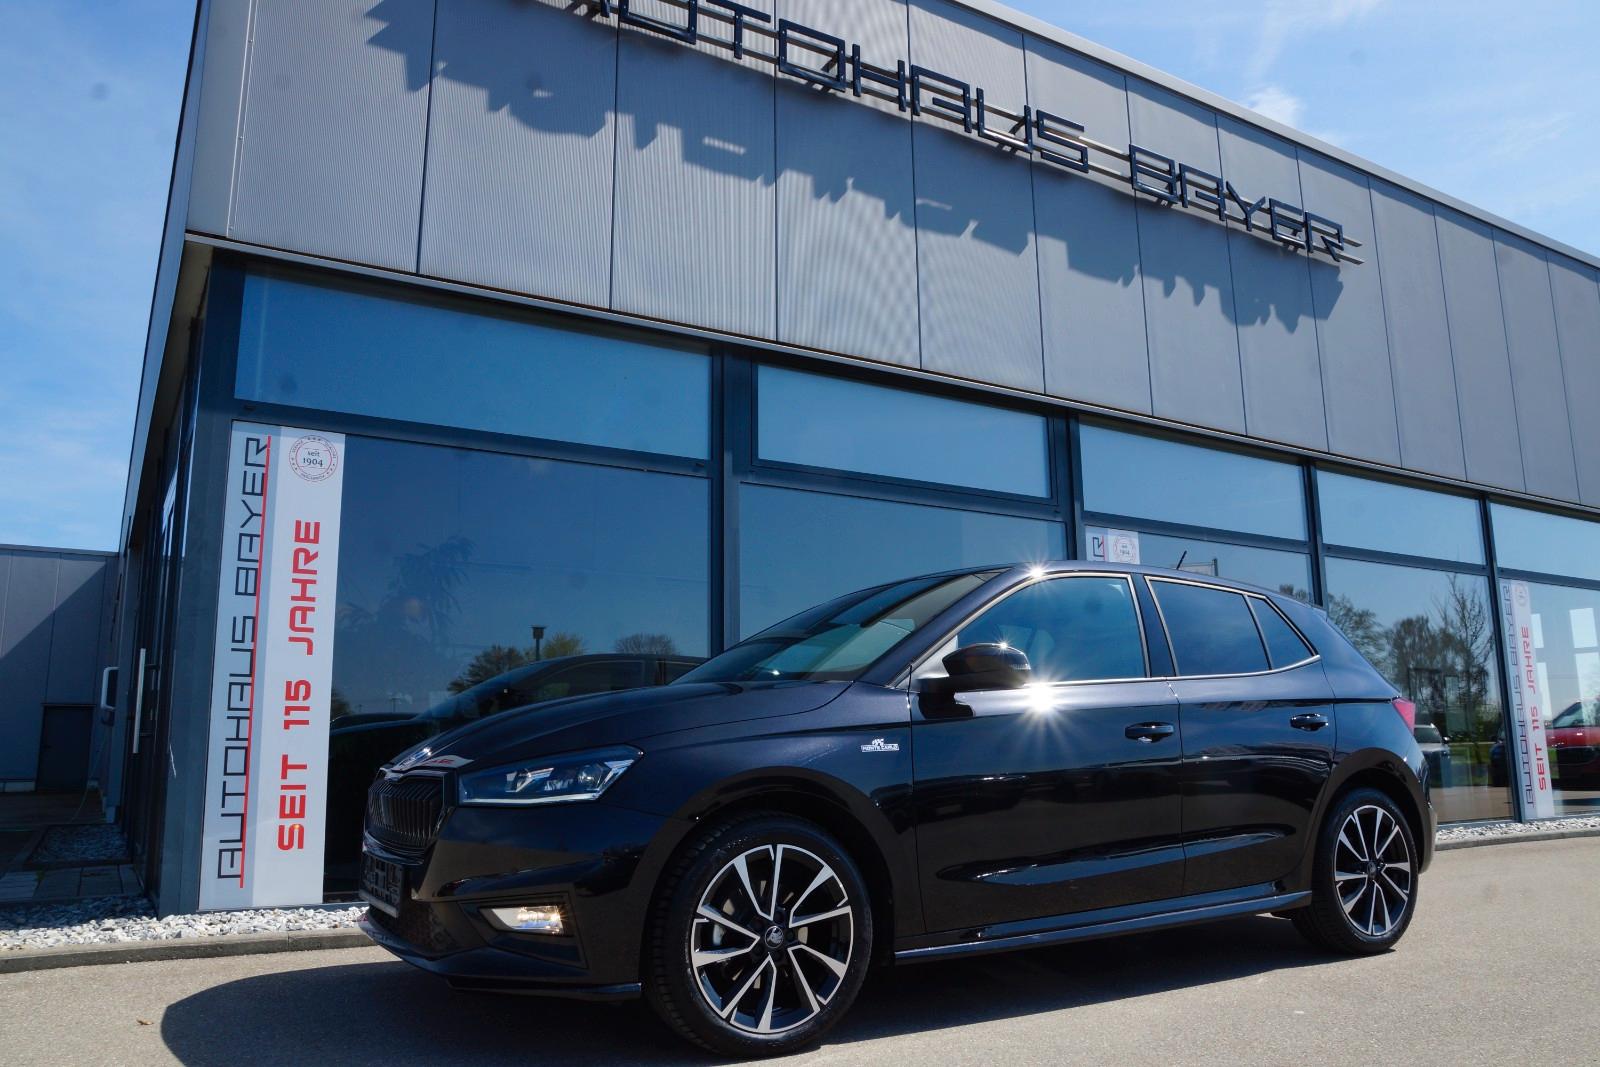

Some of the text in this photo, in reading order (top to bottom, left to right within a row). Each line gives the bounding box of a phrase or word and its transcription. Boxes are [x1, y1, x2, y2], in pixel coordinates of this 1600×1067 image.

[600, 0, 1344, 263] UTOHAUS BAYER
[303, 457, 323, 468] 1904
[217, 437, 269, 879] AUTOHAUS BAYER
[277, 520, 321, 851] SEIT 115 JAHRE
[1502, 583, 1536, 809] AUTOHAUS BAYER
[1521, 626, 1547, 791] SEIT 115 JAHRE
